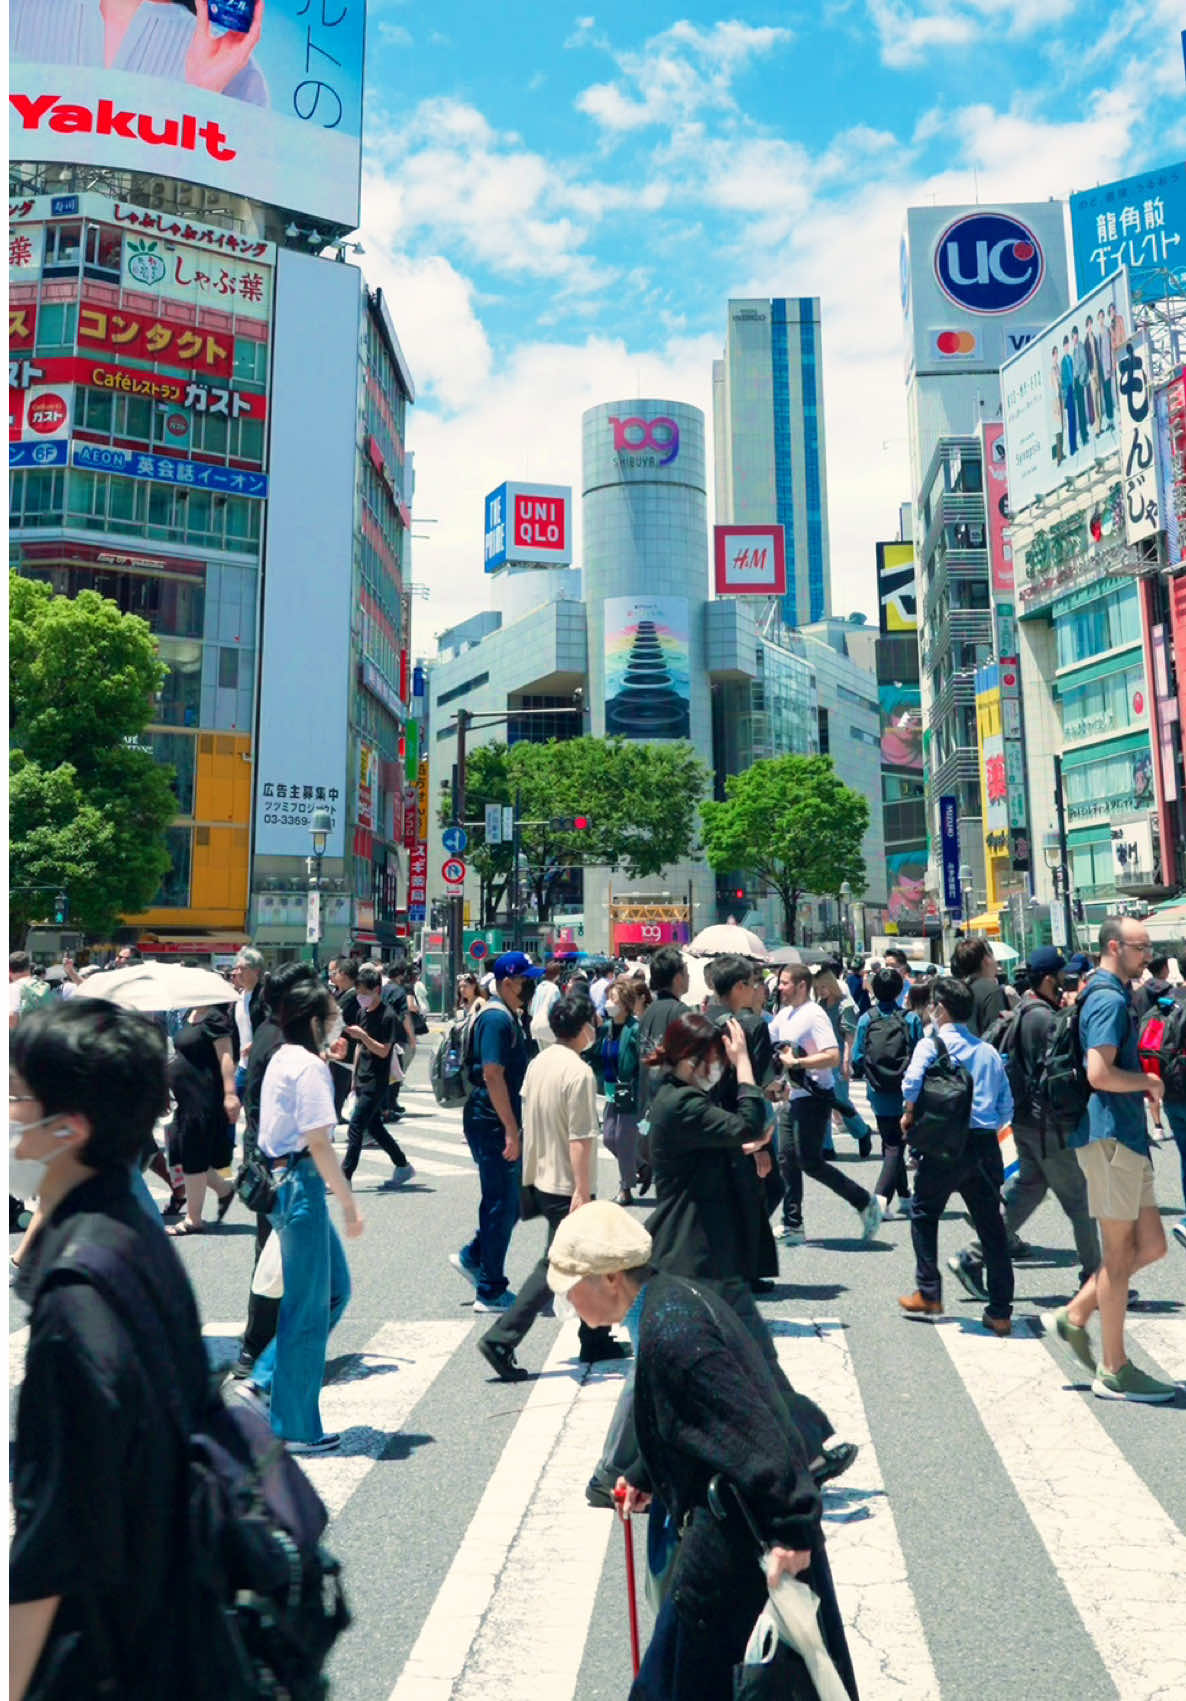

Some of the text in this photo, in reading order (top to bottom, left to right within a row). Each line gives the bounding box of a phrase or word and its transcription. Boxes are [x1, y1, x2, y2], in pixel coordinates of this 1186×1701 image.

[9, 94, 237, 162] Yakult
[114, 203, 268, 257] しゃぶしゃぶバイキング
[1096, 196, 1165, 244] 龍角散
[175, 256, 263, 302] しゃぶ葉
[79, 309, 228, 364] コンタクト
[184, 383, 251, 417] ガスト
[608, 416, 680, 466] 109
[1118, 343, 1158, 529] もんじゃ
[81, 446, 125, 465] AEON
[137, 456, 264, 491] 英会話イーオン
[520, 501, 556, 522] UNI
[520, 523, 560, 543] QLO
[733, 547, 767, 571] H&M
[263, 783, 339, 801] 広告主募集中
[641, 926, 662, 942] 109
